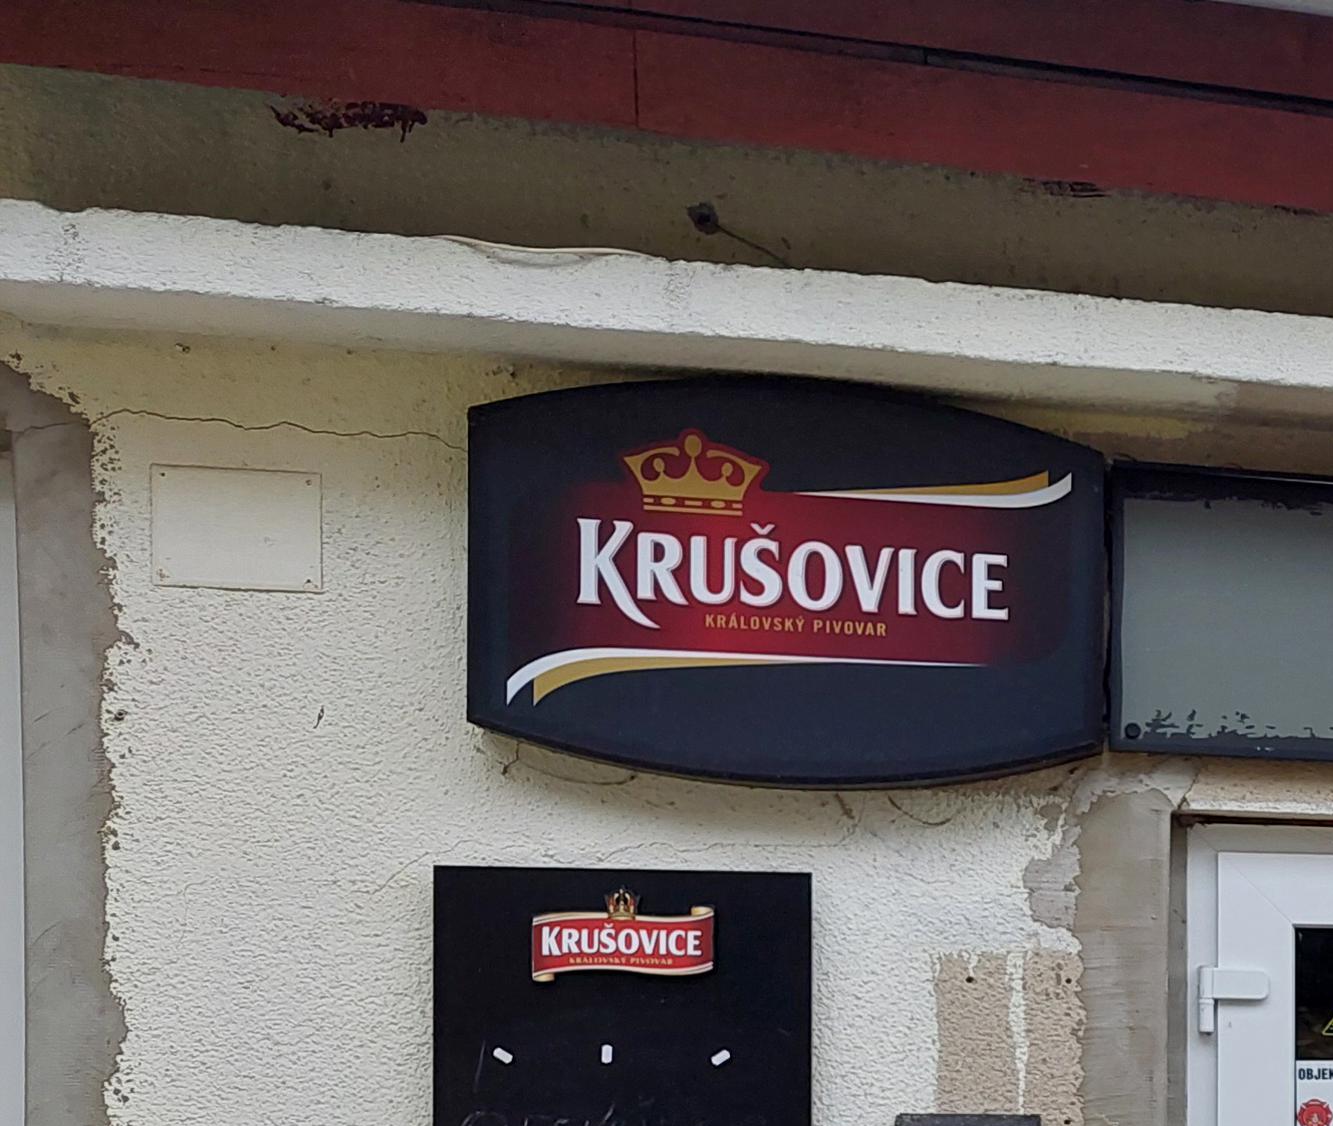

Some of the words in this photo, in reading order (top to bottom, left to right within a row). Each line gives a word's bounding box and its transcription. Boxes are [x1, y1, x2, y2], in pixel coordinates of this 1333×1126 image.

[576, 517, 1010, 630] KRUŠOVICE
[705, 612, 805, 633] KRÁLOVSKÝ
[813, 619, 887, 637] PIVOVAR
[541, 922, 703, 957] KRUŠOVICE
